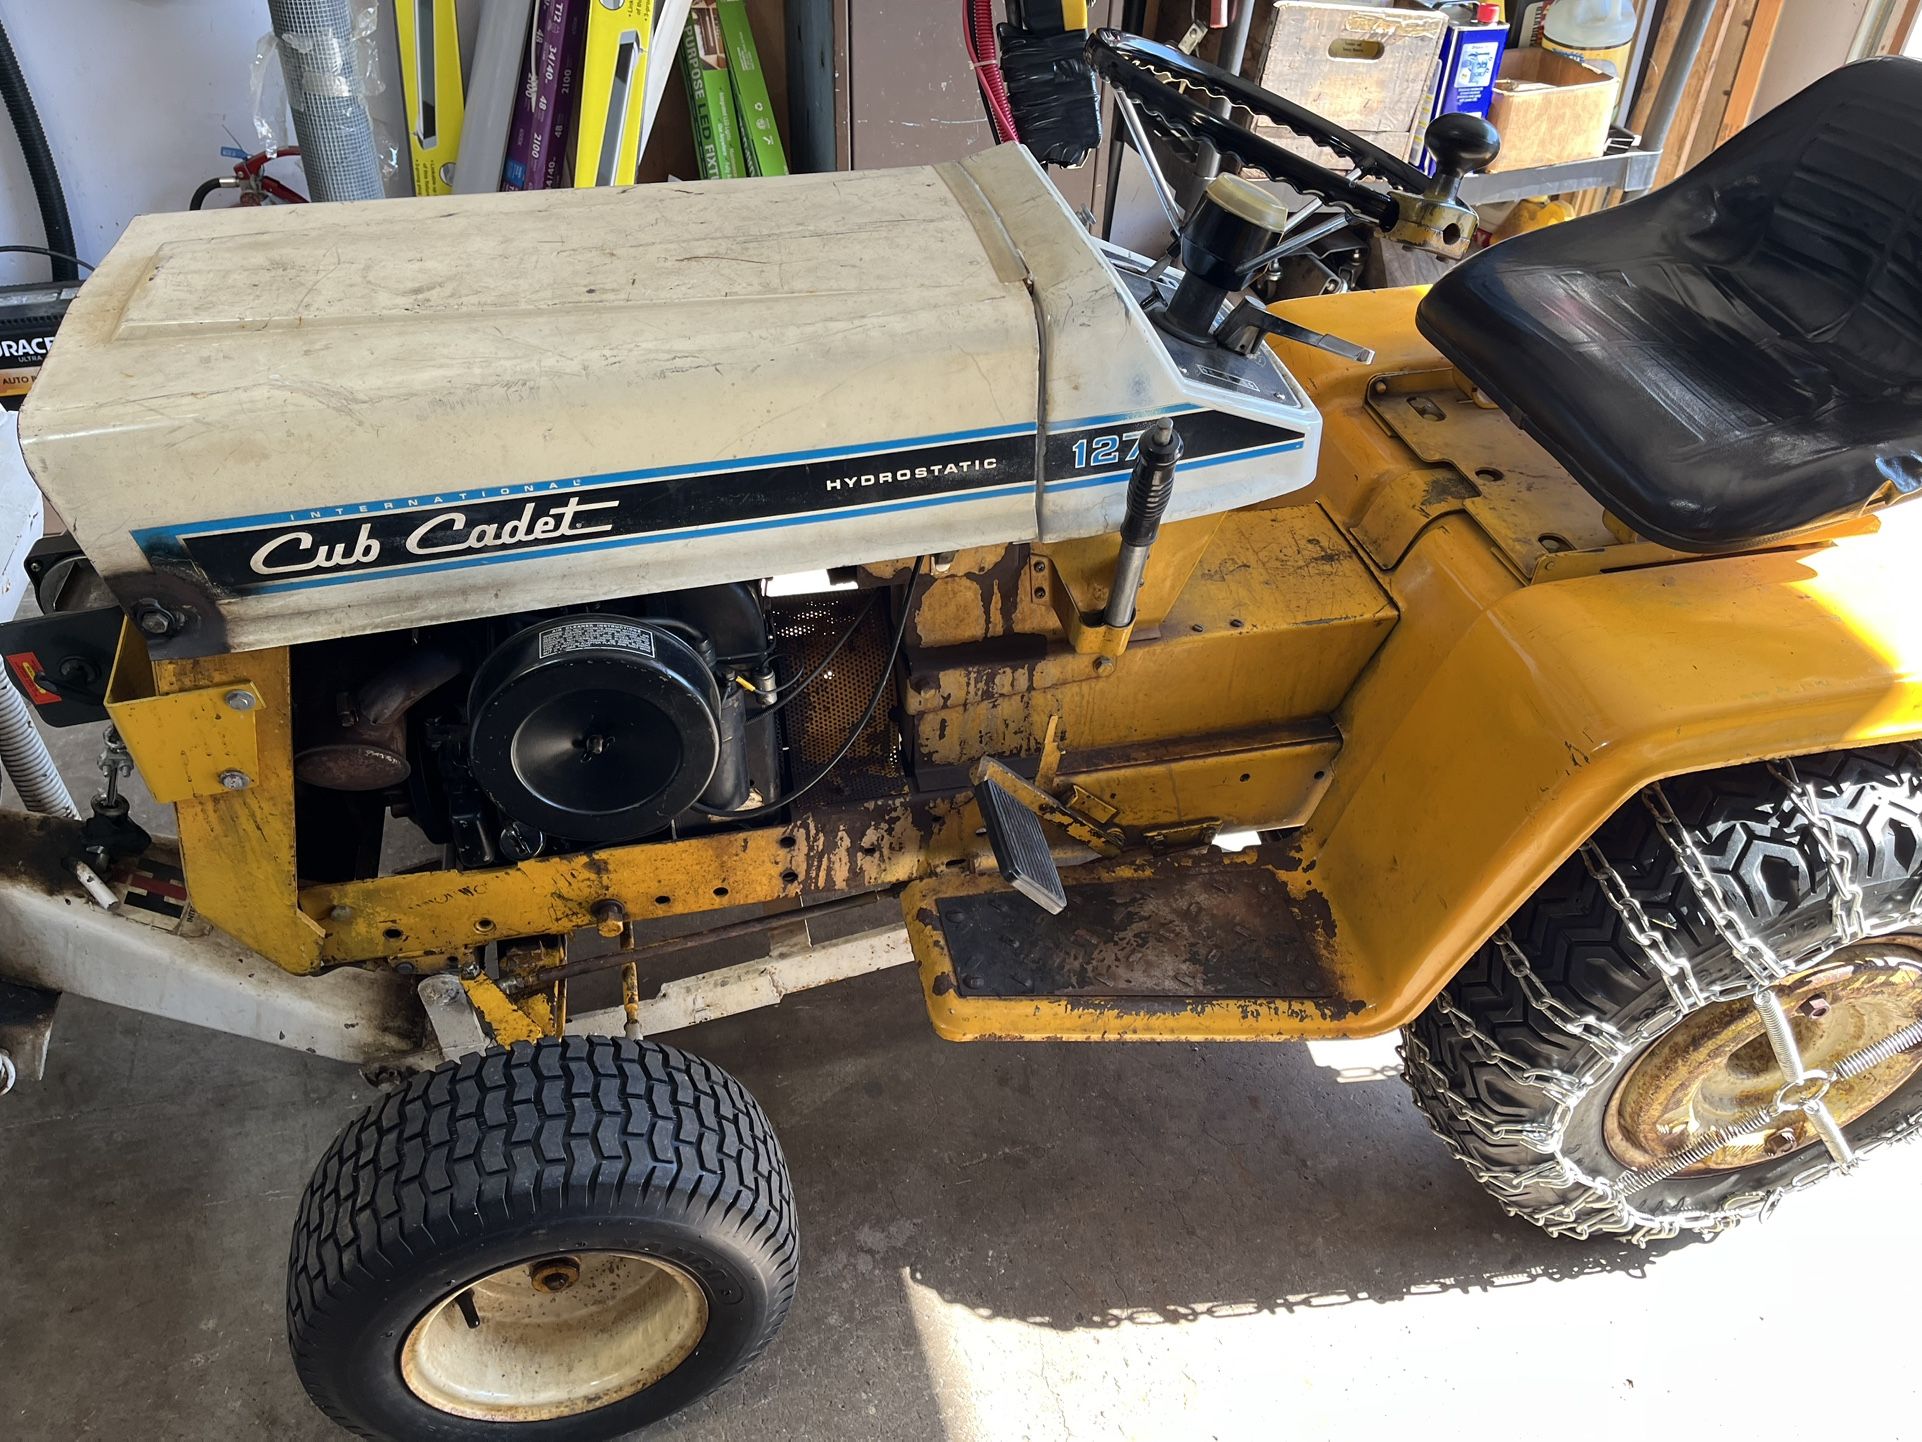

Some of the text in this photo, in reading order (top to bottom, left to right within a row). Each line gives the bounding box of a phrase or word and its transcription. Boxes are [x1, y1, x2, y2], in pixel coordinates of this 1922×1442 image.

[562, 69, 572, 94] 2100
[684, 25, 705, 100] PURPOSE
[697, 103, 712, 141] LED
[539, 96, 548, 110] 48
[531, 132, 542, 158] 2100
[0, 337, 55, 357] RAC
[3, 376, 29, 385] AUTO
[826, 456, 998, 492] HYDROSTATIC
[289, 479, 581, 522] INTERNATIONAL
[249, 496, 620, 575] Cub Cadet
